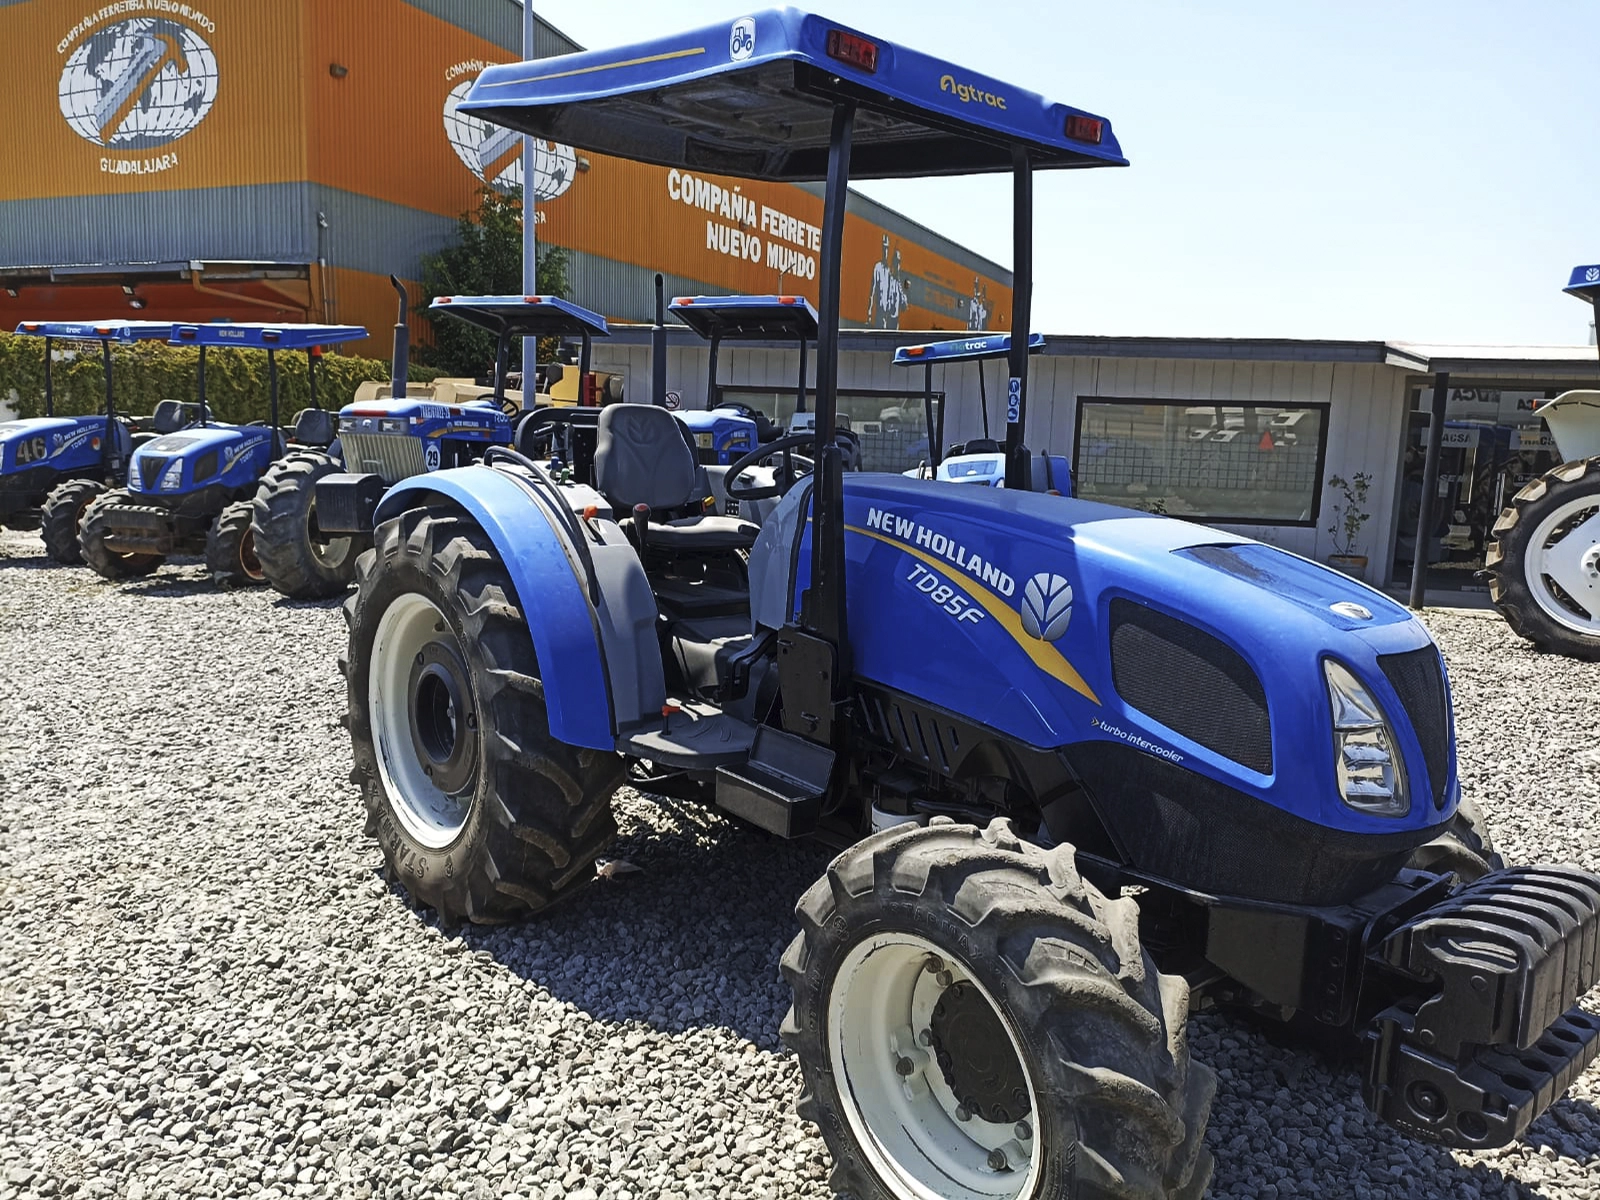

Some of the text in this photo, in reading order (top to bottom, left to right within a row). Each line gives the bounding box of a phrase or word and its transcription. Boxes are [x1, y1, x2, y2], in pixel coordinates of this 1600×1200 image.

[99, 0, 145, 20] FERRETERA
[146, 0, 179, 12] NUEVO
[179, 4, 216, 33] MUNDO
[939, 74, 1008, 110] Agtrac
[100, 152, 179, 175] GUADALAJARA
[667, 168, 821, 252] COMPAÑIA FERRETE
[706, 220, 816, 281] NUEVO MUNDO
[16, 437, 47, 463] 46
[427, 450, 438, 467] 29
[866, 507, 1015, 597] NEW HOLLAND
[906, 563, 986, 626] TD85F
[1100, 720, 1184, 763] turbo intercooler
